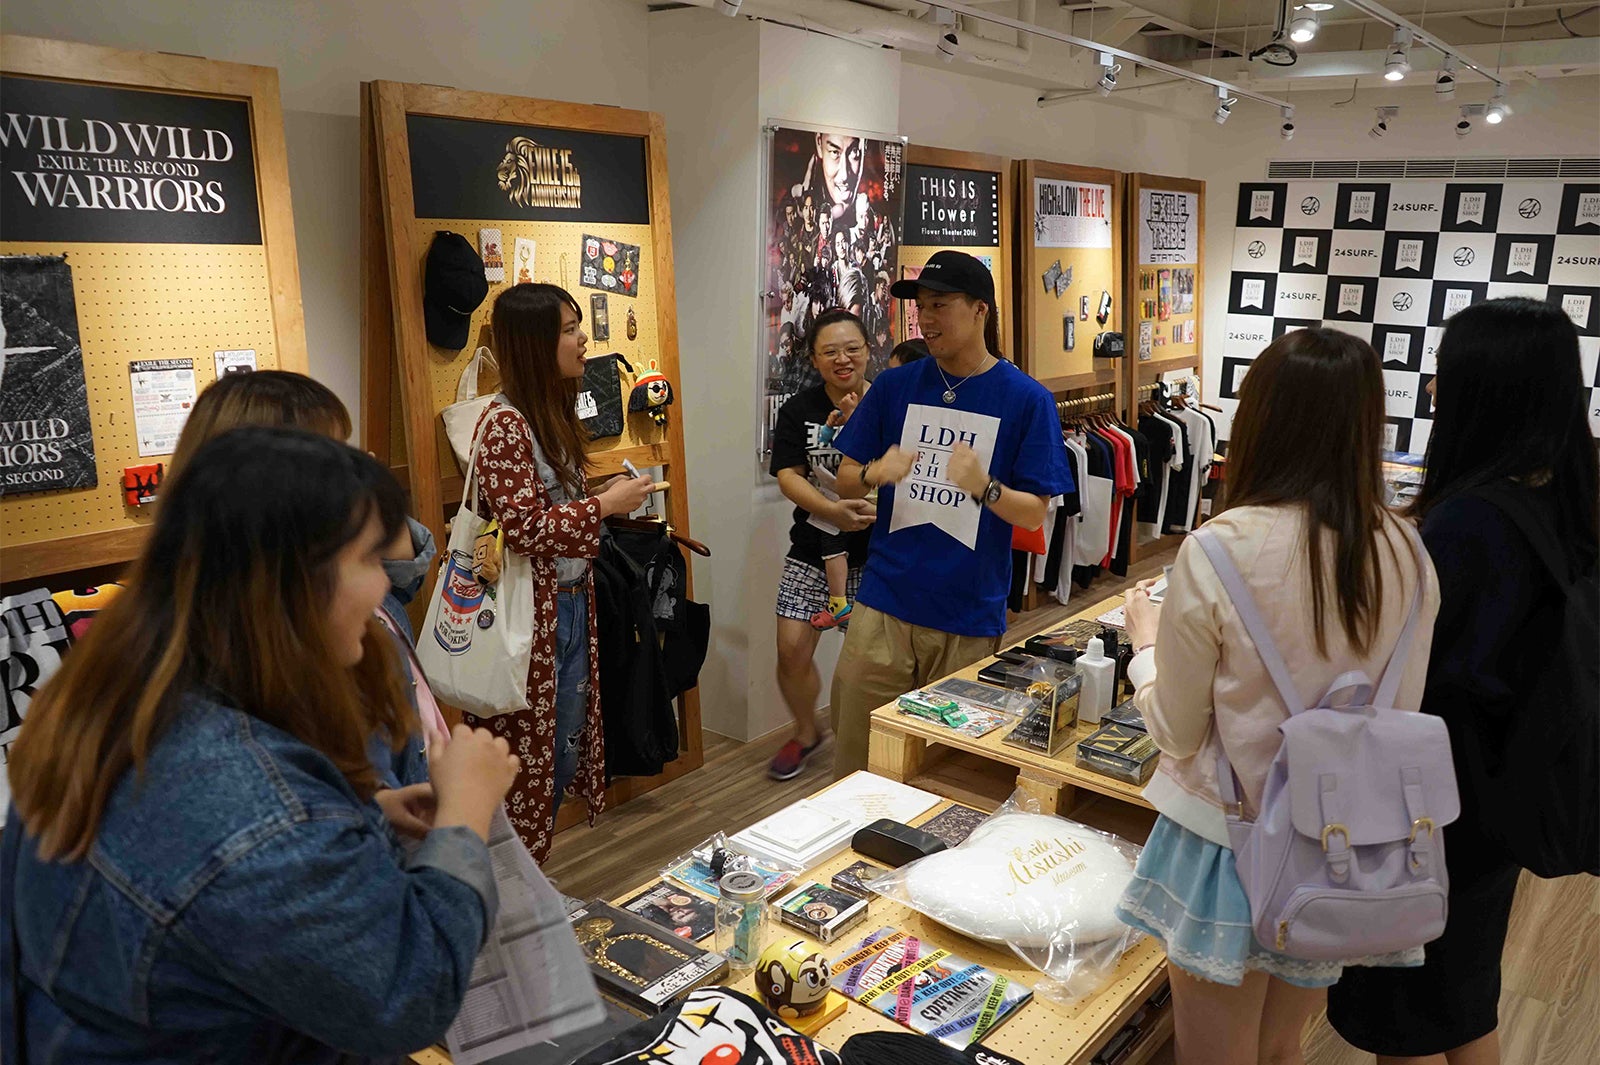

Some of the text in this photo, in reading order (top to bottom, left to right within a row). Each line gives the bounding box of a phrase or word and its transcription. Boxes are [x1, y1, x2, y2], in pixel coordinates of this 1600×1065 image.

[0, 112, 234, 162] WILD WILD
[37, 153, 200, 177] EXILE THE SECOND
[528, 147, 559, 185] EXILE
[11, 170, 226, 214] WARRIORS
[531, 185, 581, 209] ANNIVERSARY
[920, 176, 976, 200] THIS IS
[921, 201, 976, 223] Flower
[1078, 187, 1091, 218] THE
[1091, 188, 1105, 219] LIVE
[1150, 192, 1189, 222] EXILE
[921, 227, 977, 237] Flower Theater 2016
[1146, 219, 1187, 250] TRIBE
[1150, 253, 1187, 263] STATION
[918, 424, 978, 449] LDH
[5, 468, 65, 485] SECOND
[909, 482, 967, 508] SHOP
[1007, 838, 1053, 864] Exile
[843, 948, 874, 967] DANGER!
[872, 940, 890, 952] KEEP
[887, 931, 906, 943] OUT!
[878, 978, 896, 992] KEEP
[894, 969, 912, 982] OUT!
[917, 950, 946, 969] DANGER!
[921, 964, 986, 997] KEEP OUT! DANG
[956, 1016, 978, 1029] KEEP
[975, 983, 1004, 1036] DANGER! KEEP OUT!
